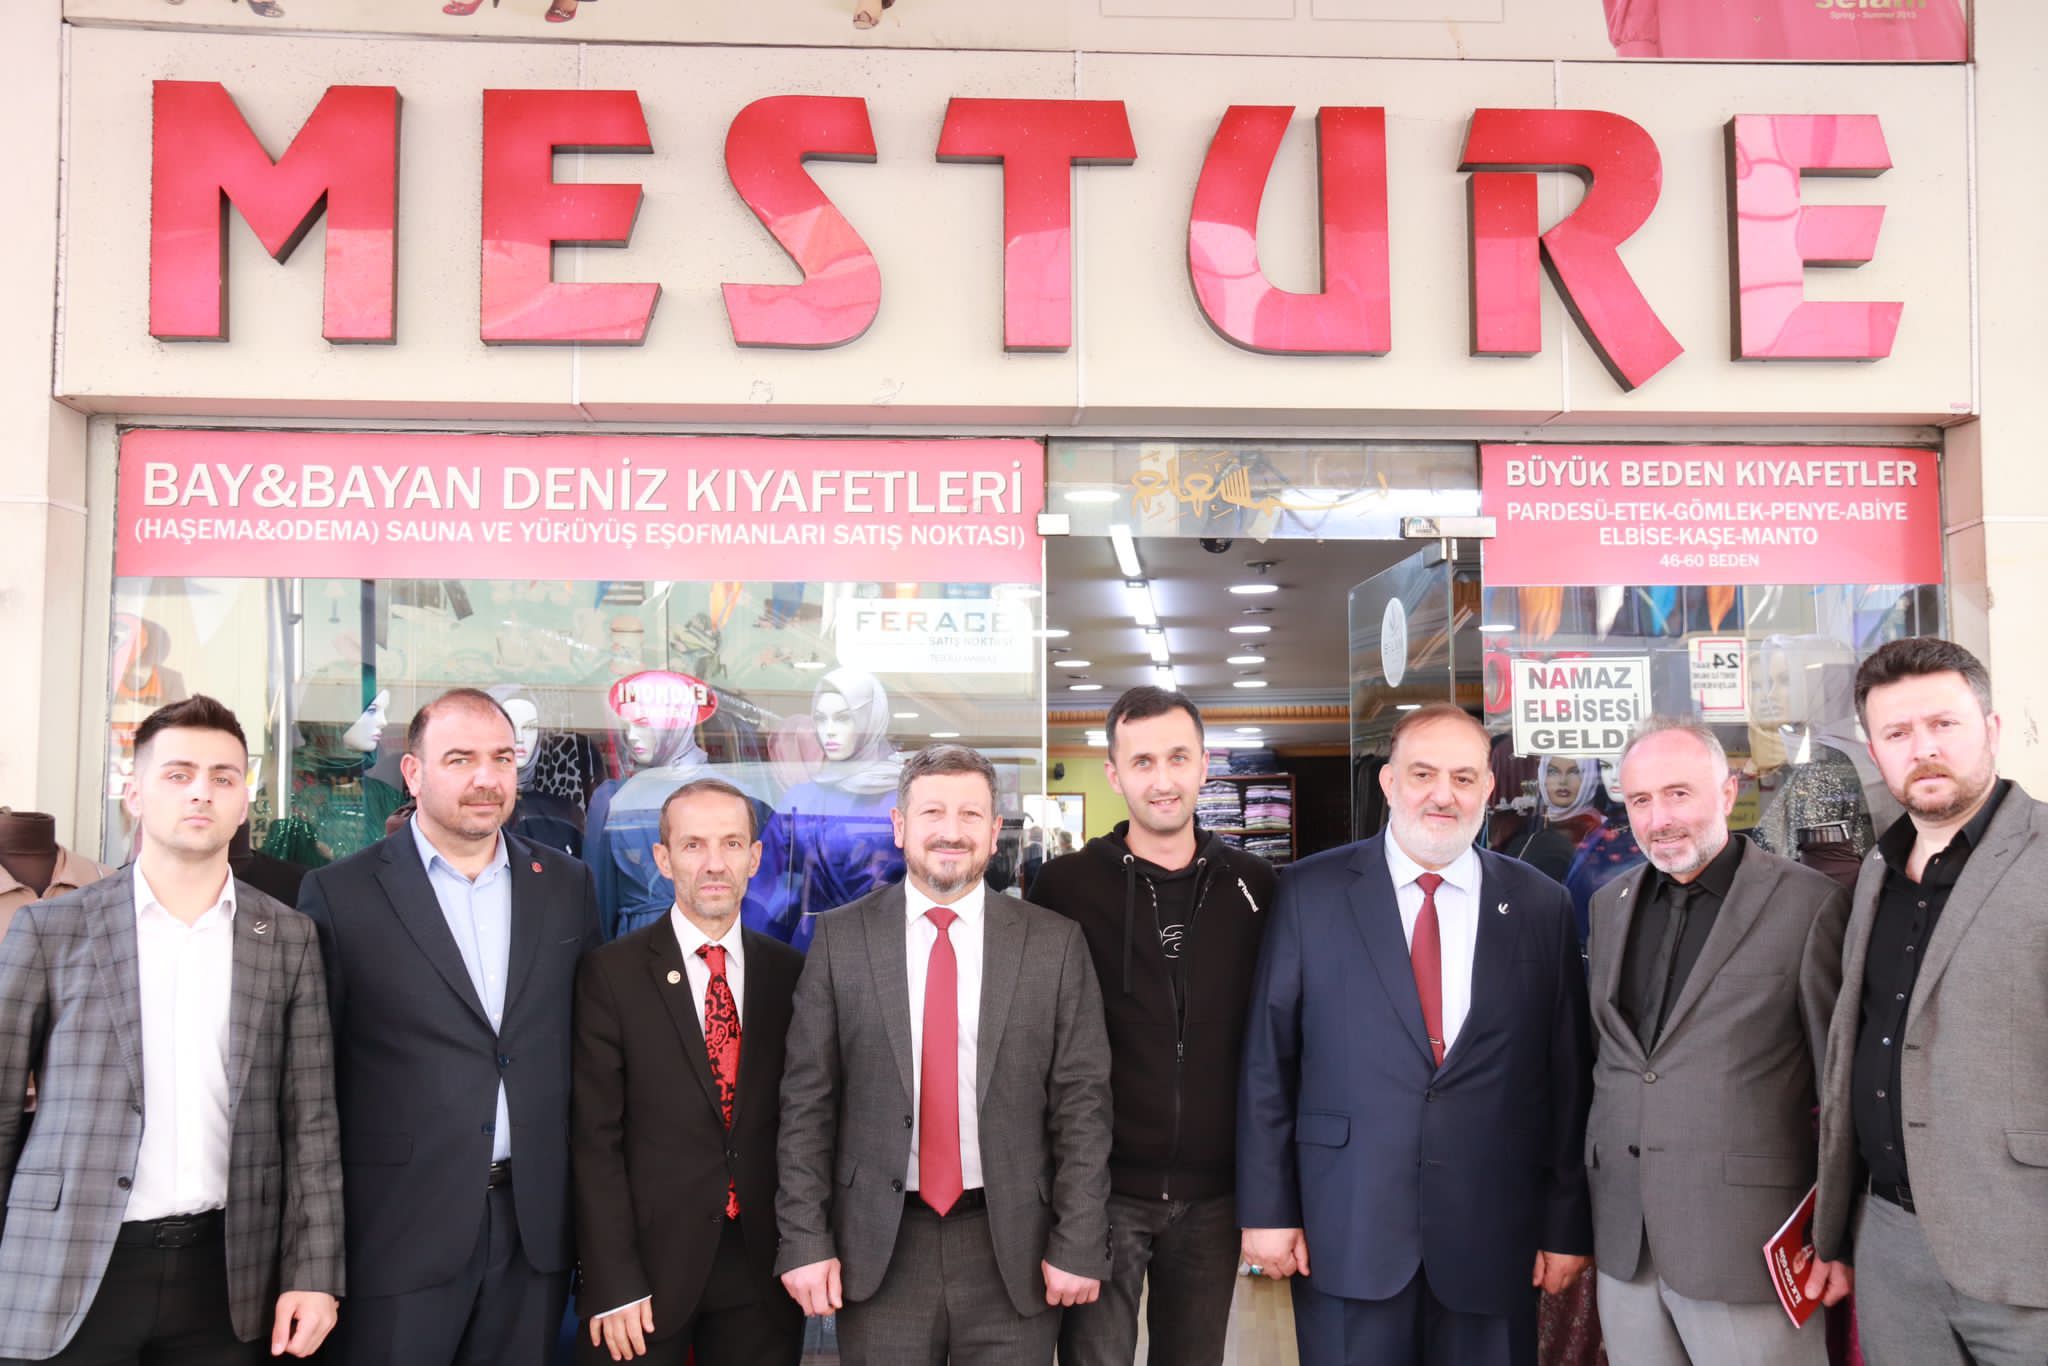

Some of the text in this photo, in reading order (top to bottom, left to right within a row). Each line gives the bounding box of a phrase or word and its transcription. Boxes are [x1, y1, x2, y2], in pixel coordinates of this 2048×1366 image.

[148, 80, 1905, 393] MESTURE
[143, 457, 1024, 515] BAY&BAYAN DENİZ KIYAFETLERİ
[1506, 455, 1918, 488] BÜYÜK BEDEN KIYAFETLER
[134, 517, 1026, 551] (HAŞEMA&ODEMA) SAUNA VE YÜRÜYÜŞ EŞOFMANLARI SATIŞ NOKTASI)
[1659, 554, 1760, 568] 46-60 BEDEN
[856, 611, 1013, 633] FERACE
[1528, 667, 1632, 689] NAMAZ
[1524, 693, 1639, 722] ELBİSESİ
